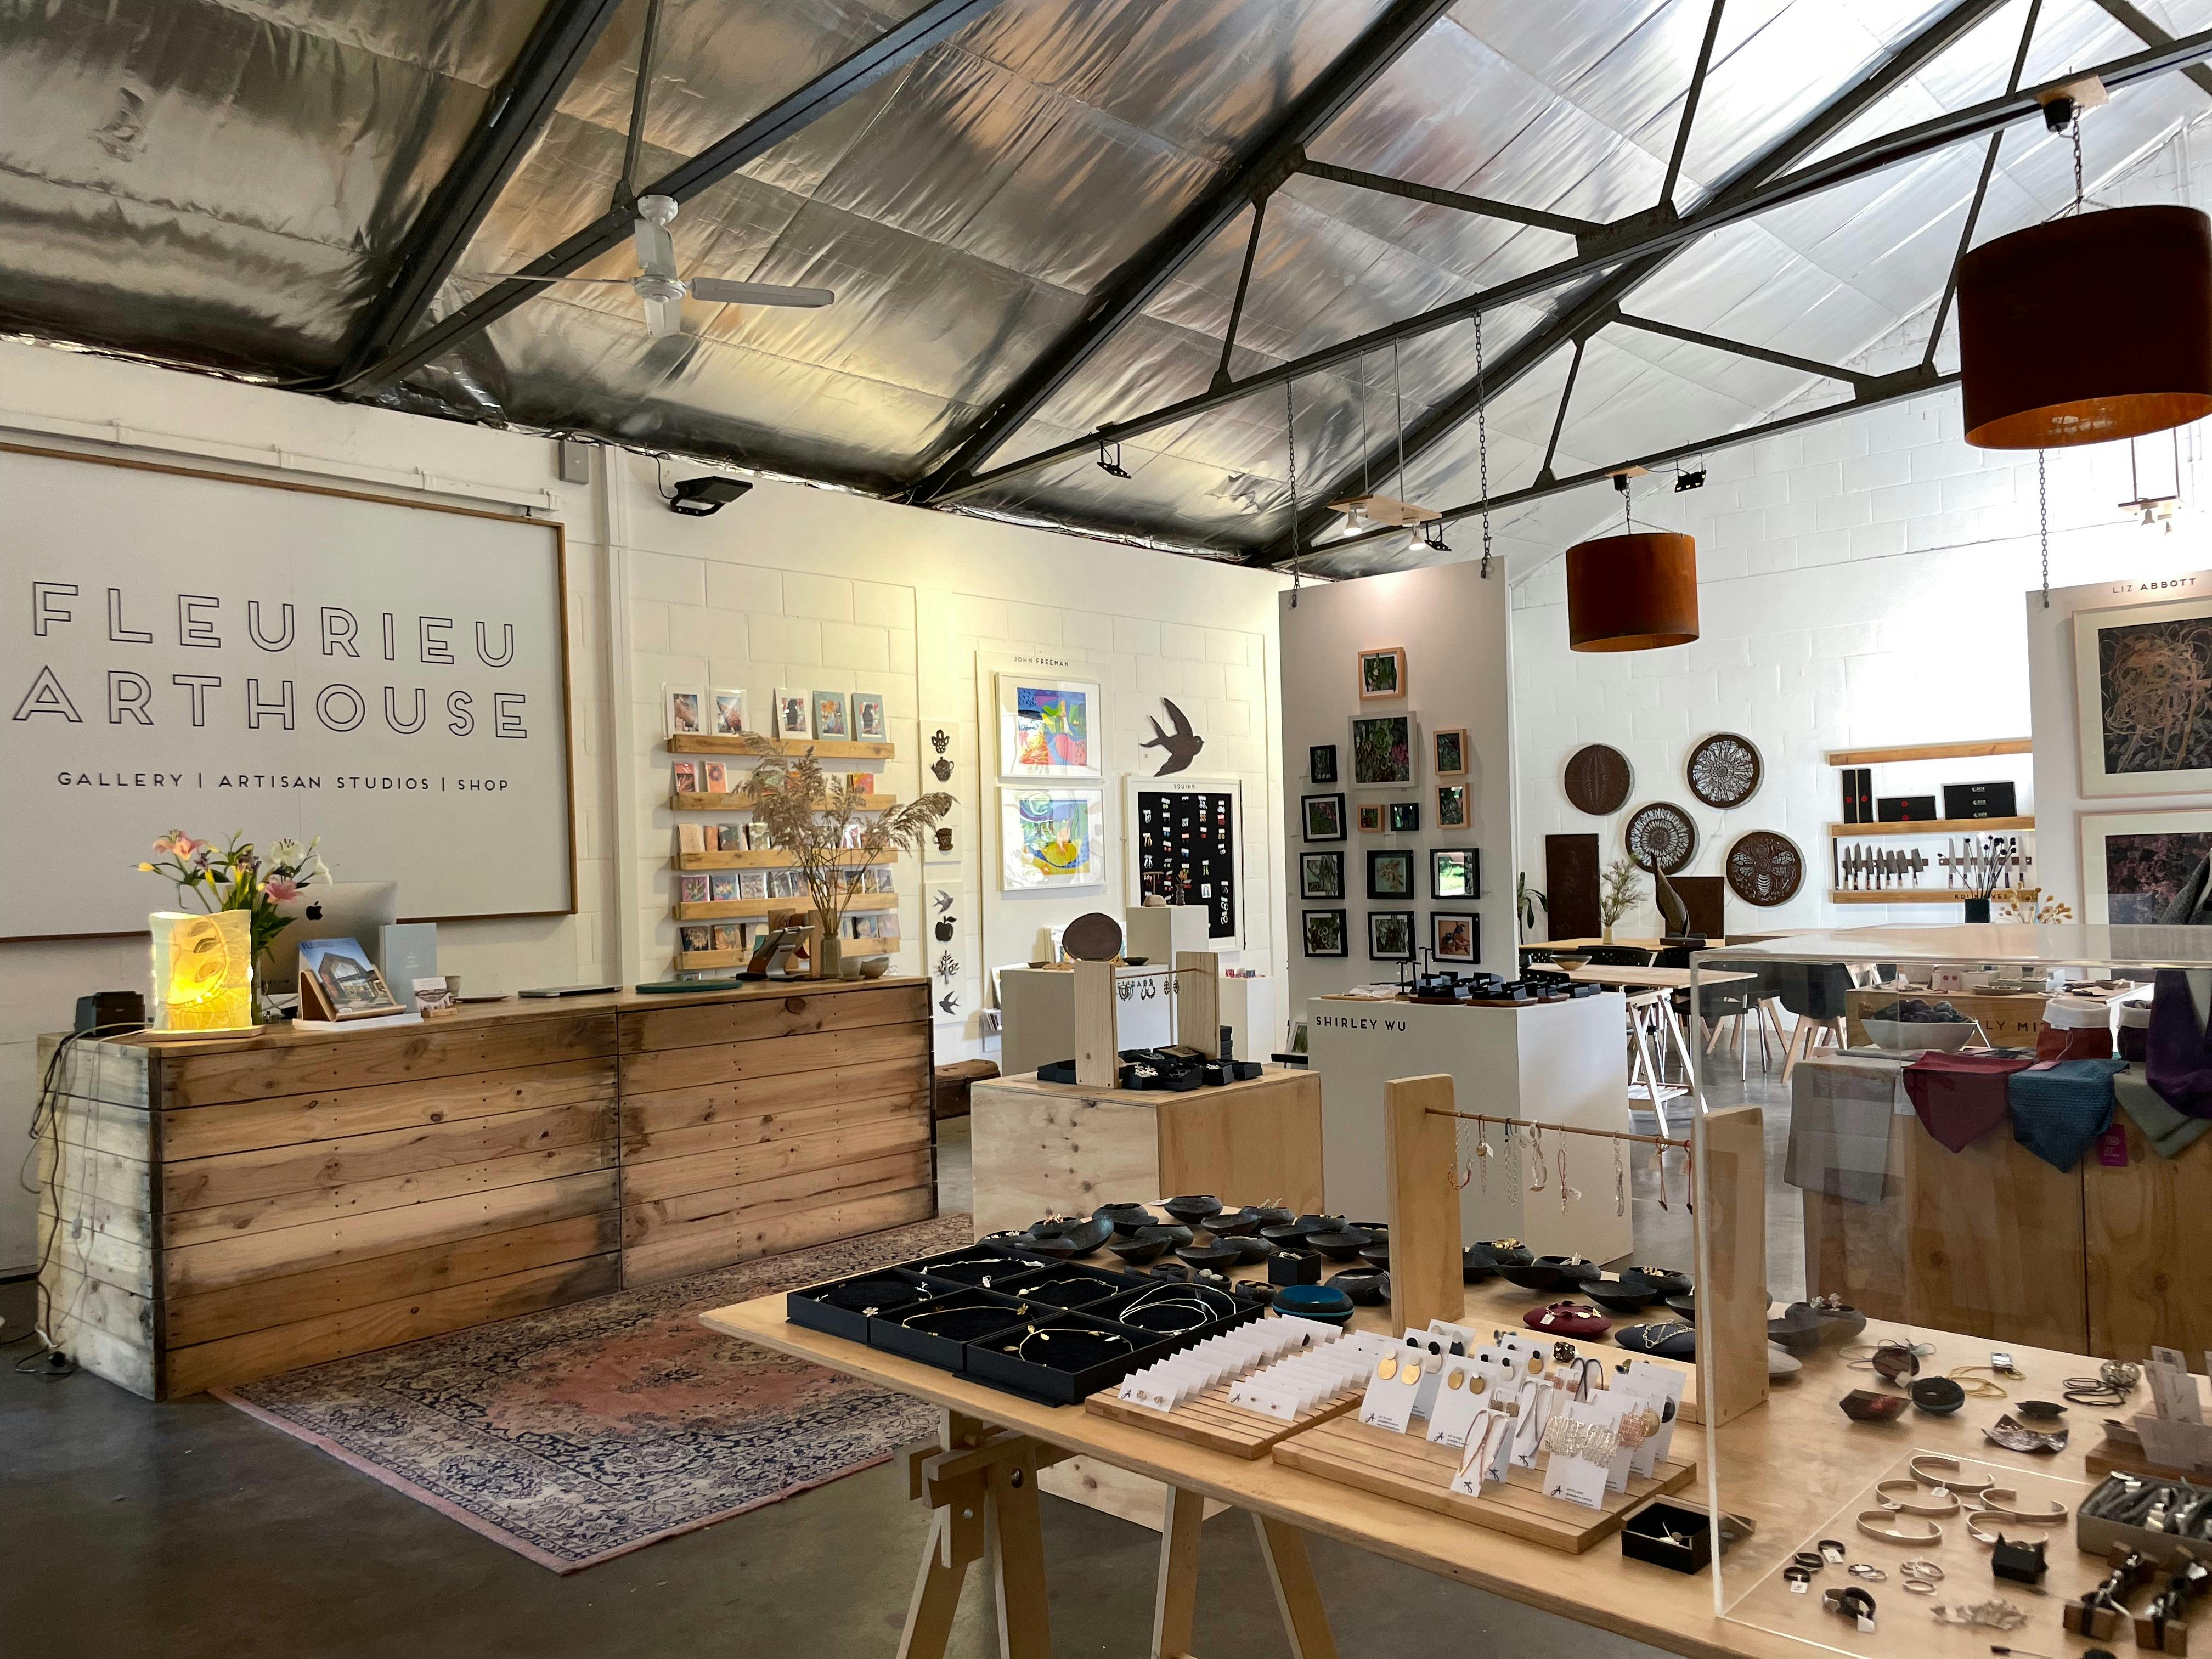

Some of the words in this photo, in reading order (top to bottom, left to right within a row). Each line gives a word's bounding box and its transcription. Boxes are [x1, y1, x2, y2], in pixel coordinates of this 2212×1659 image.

[2113, 584, 2132, 594] LIZ
[2140, 578, 2196, 591] ABBOTT
[33, 581, 514, 668] FLEURIEU
[1036, 658, 1069, 667] FREEMAN
[12, 664, 527, 739] ARTHOUSE
[58, 772, 183, 787] GALLERY
[219, 775, 321, 789] ARTISAN
[337, 776, 430, 790] STUDIOS
[458, 778, 509, 792] SHOP
[1316, 1016, 1378, 1030] SHIRLEY
[1385, 1020, 1406, 1031] WU
[1985, 1020, 2005, 1031] LY
[2017, 1022, 2044, 1032] MI
